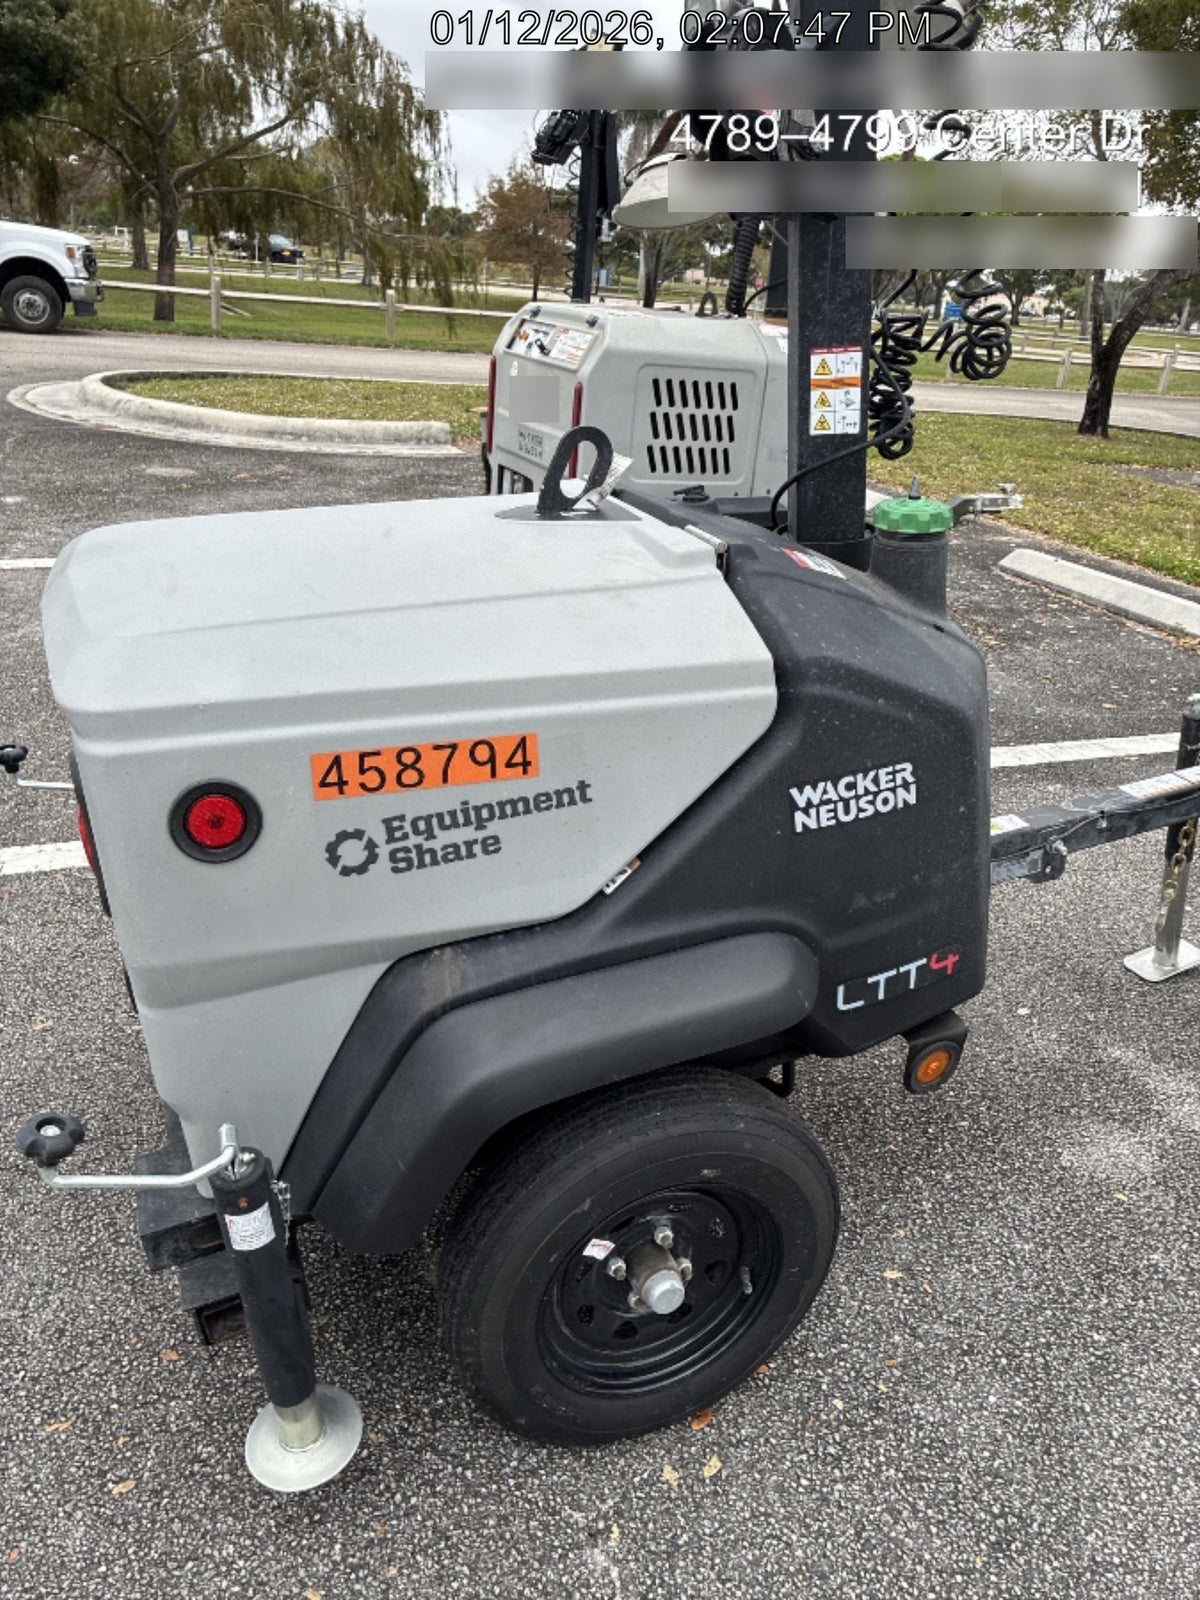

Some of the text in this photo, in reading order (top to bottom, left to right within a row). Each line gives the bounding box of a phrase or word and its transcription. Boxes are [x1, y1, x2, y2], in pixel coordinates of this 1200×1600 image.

[318, 735, 533, 796] 458794
[789, 762, 917, 808] WACKER
[381, 779, 593, 844] Equipment
[793, 783, 917, 833] NEUSON
[388, 833, 503, 874] Share
